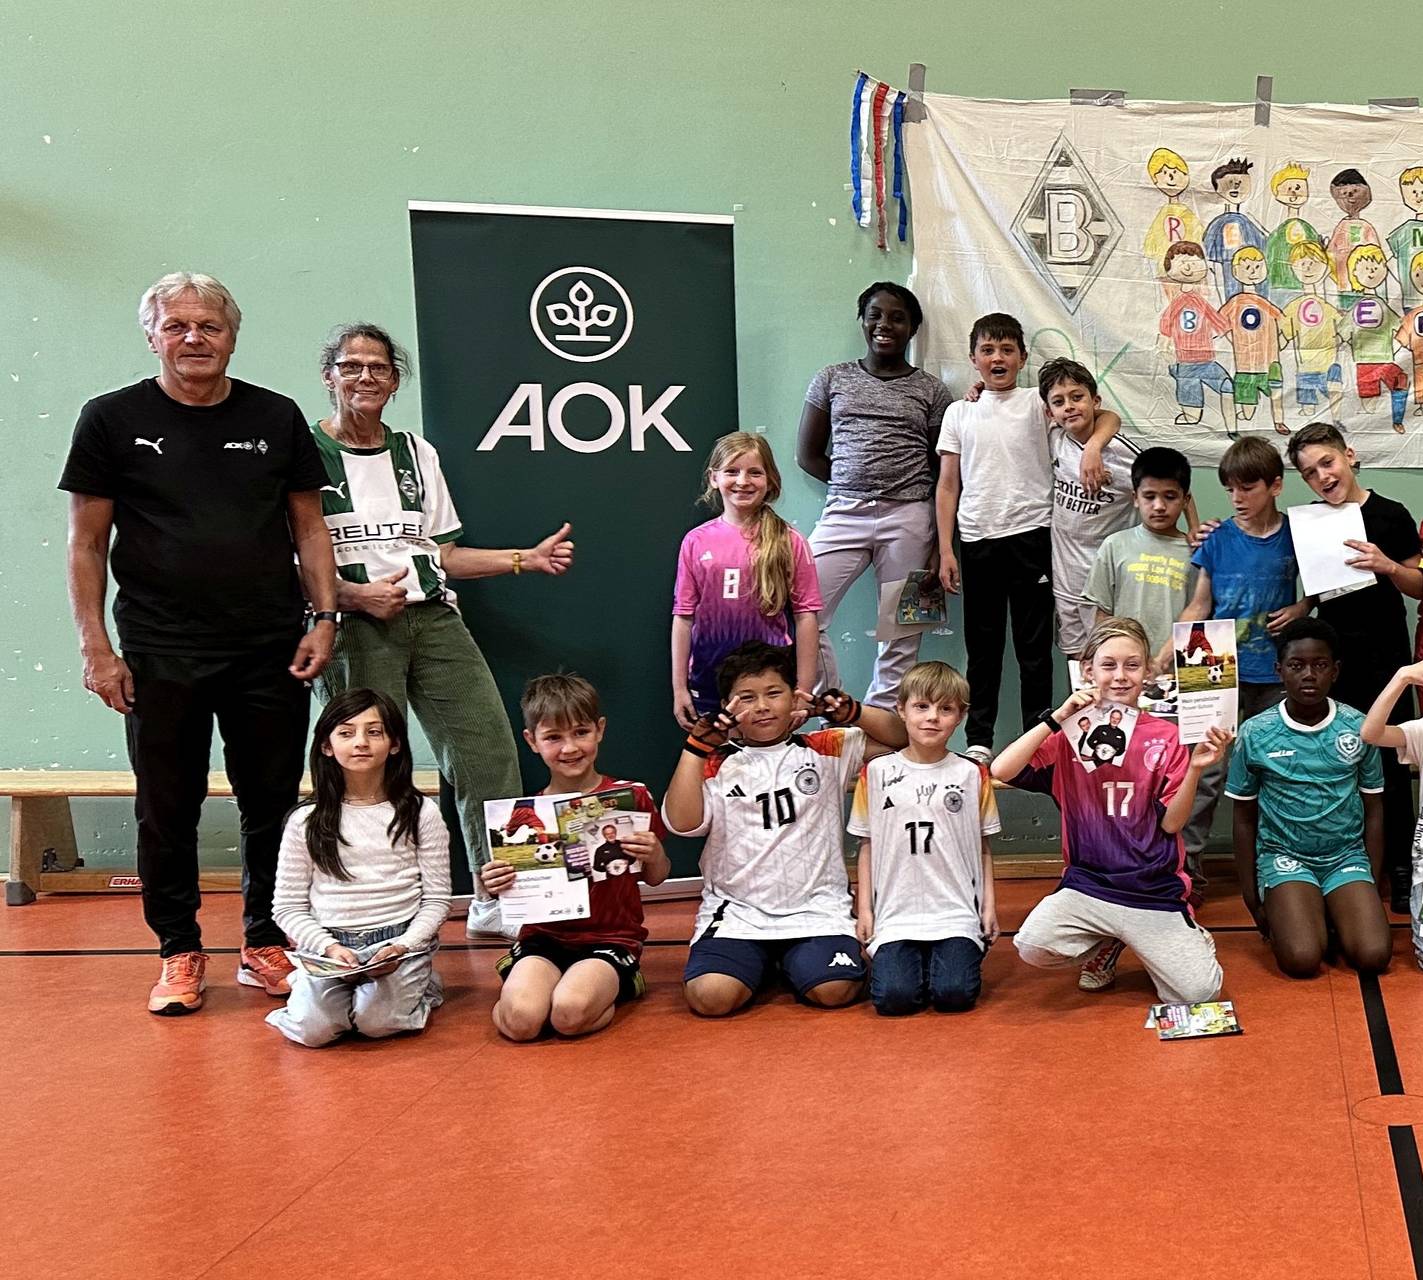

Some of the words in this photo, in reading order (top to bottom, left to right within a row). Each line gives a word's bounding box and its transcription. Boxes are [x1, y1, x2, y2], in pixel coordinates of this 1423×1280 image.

[1045, 188, 1096, 265] B
[476, 382, 693, 453] AOK
[1054, 480, 1116, 503] miraes
[1066, 498, 1101, 515] BETTER
[723, 568, 740, 598] 8
[756, 787, 796, 829] 10
[1103, 782, 1134, 817] 17
[905, 821, 934, 854] 17
